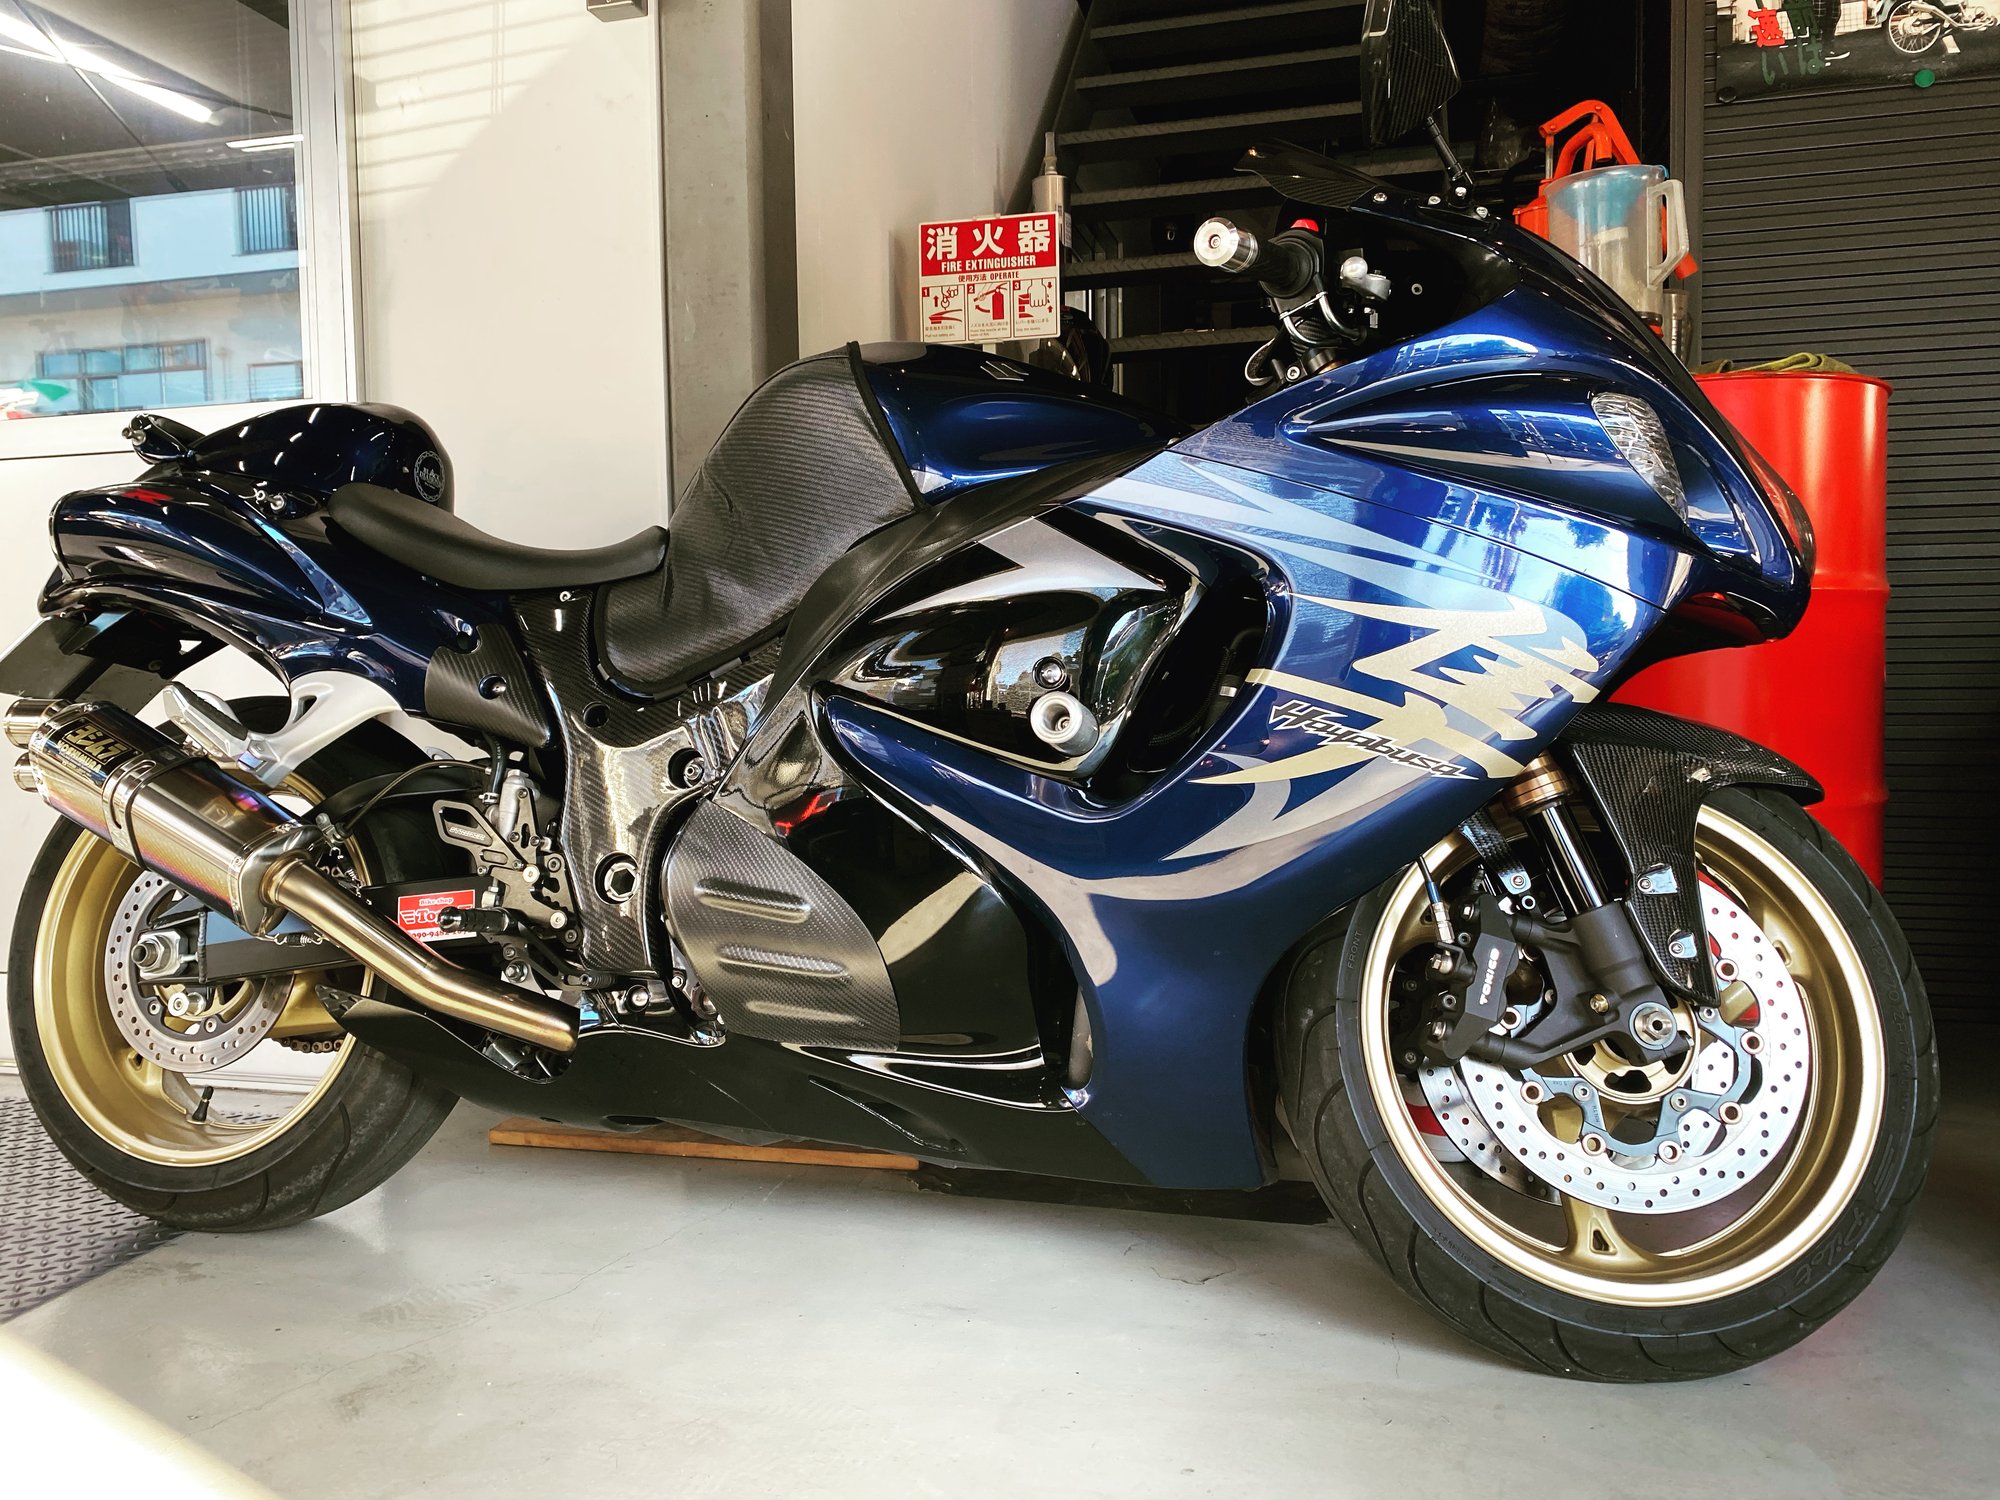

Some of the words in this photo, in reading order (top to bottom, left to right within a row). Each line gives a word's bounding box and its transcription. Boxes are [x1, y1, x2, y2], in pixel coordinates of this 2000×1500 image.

[926, 219, 1051, 261] 消火器
[941, 260, 962, 273] FIRE
[965, 254, 1037, 270] EXTINGUISHER
[958, 274, 987, 282] 使用方法
[990, 271, 1019, 280] OPERATE
[57, 740, 103, 772] YOSHIMURA
[1269, 699, 1480, 780] Hayabusa
[1346, 930, 1366, 970] FRONT
[1479, 947, 1500, 1006] TOKICO
[1795, 1206, 1869, 1286] Pilot
